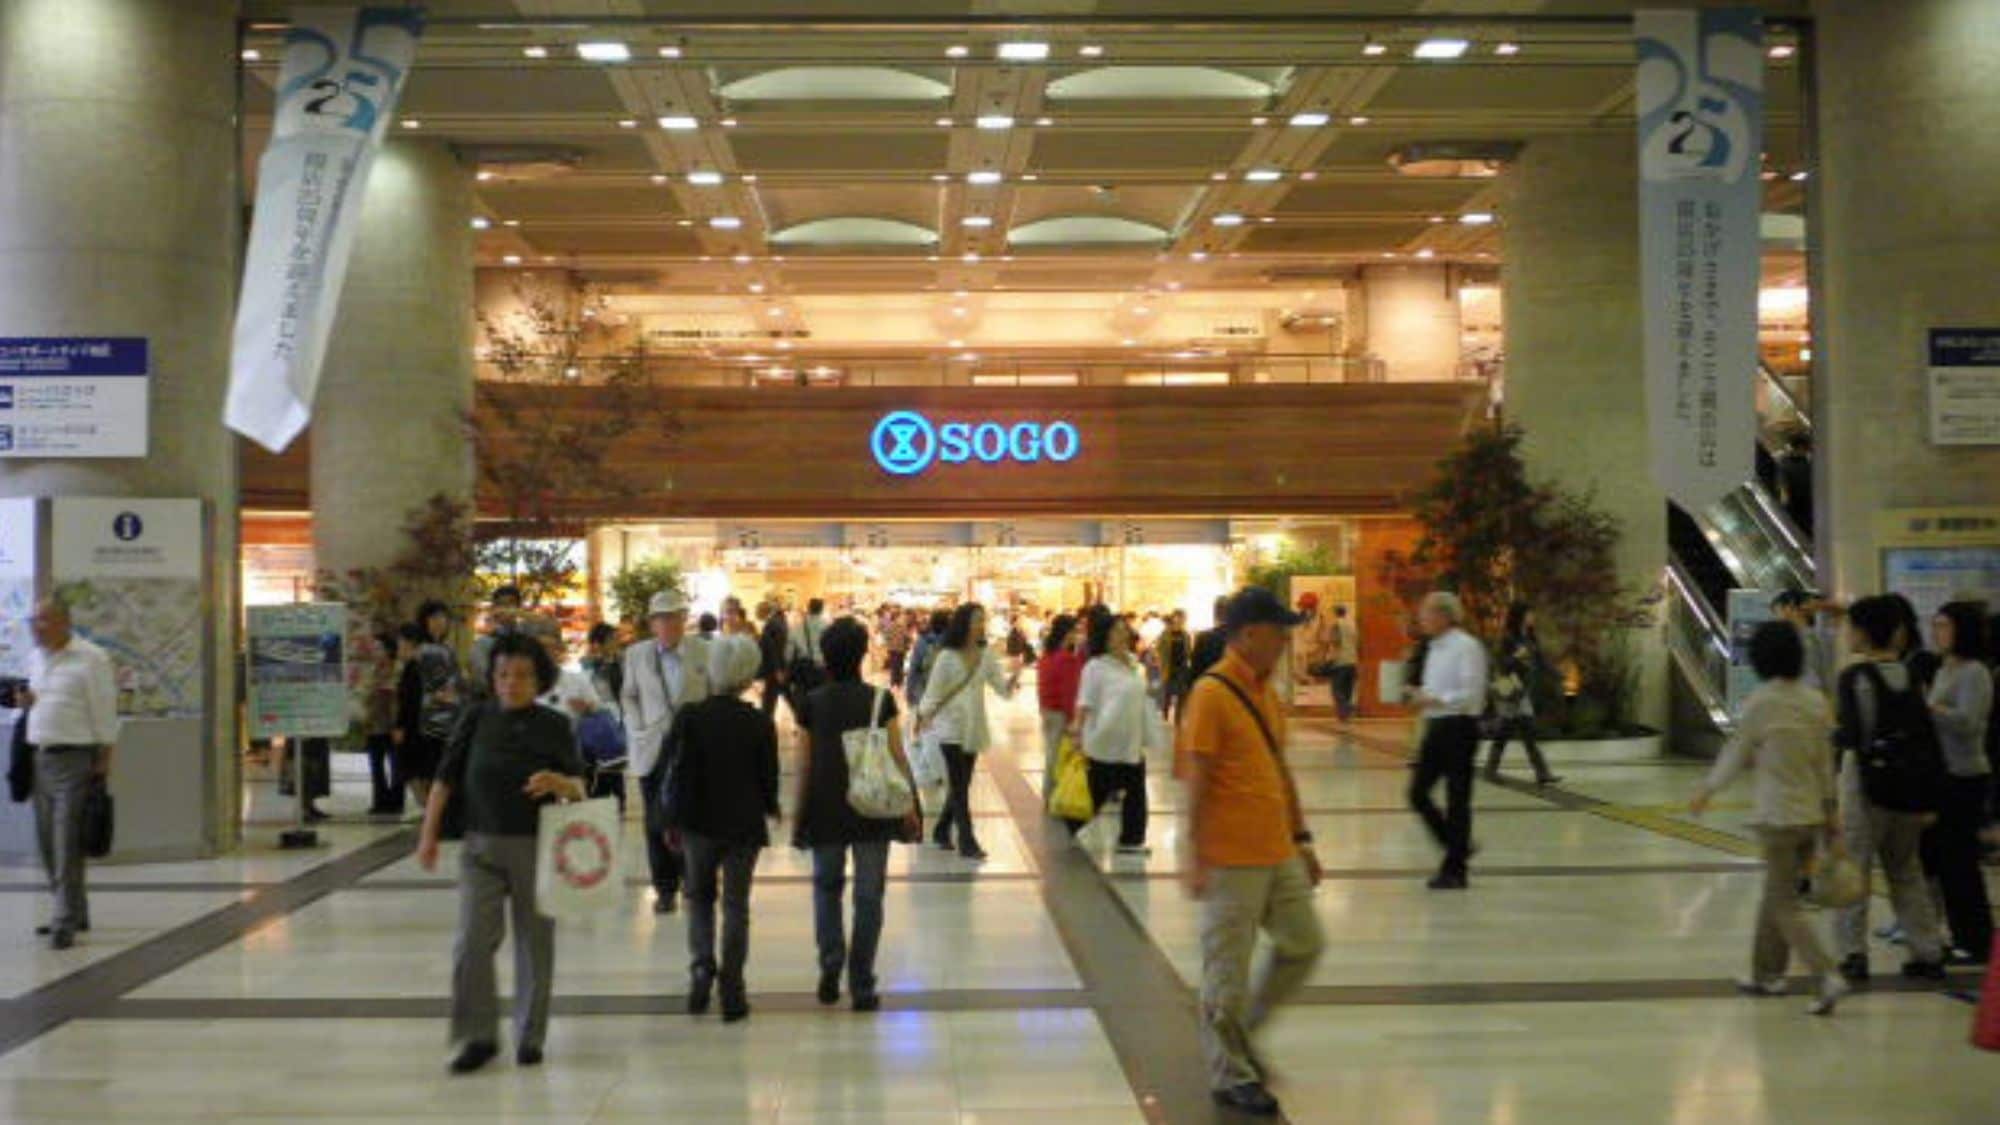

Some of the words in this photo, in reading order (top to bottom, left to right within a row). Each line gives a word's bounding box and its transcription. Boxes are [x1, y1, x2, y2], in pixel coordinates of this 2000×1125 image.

[304, 72, 377, 132] 25
[1668, 97, 1731, 167] 25
[940, 421, 1078, 462] SOGO
